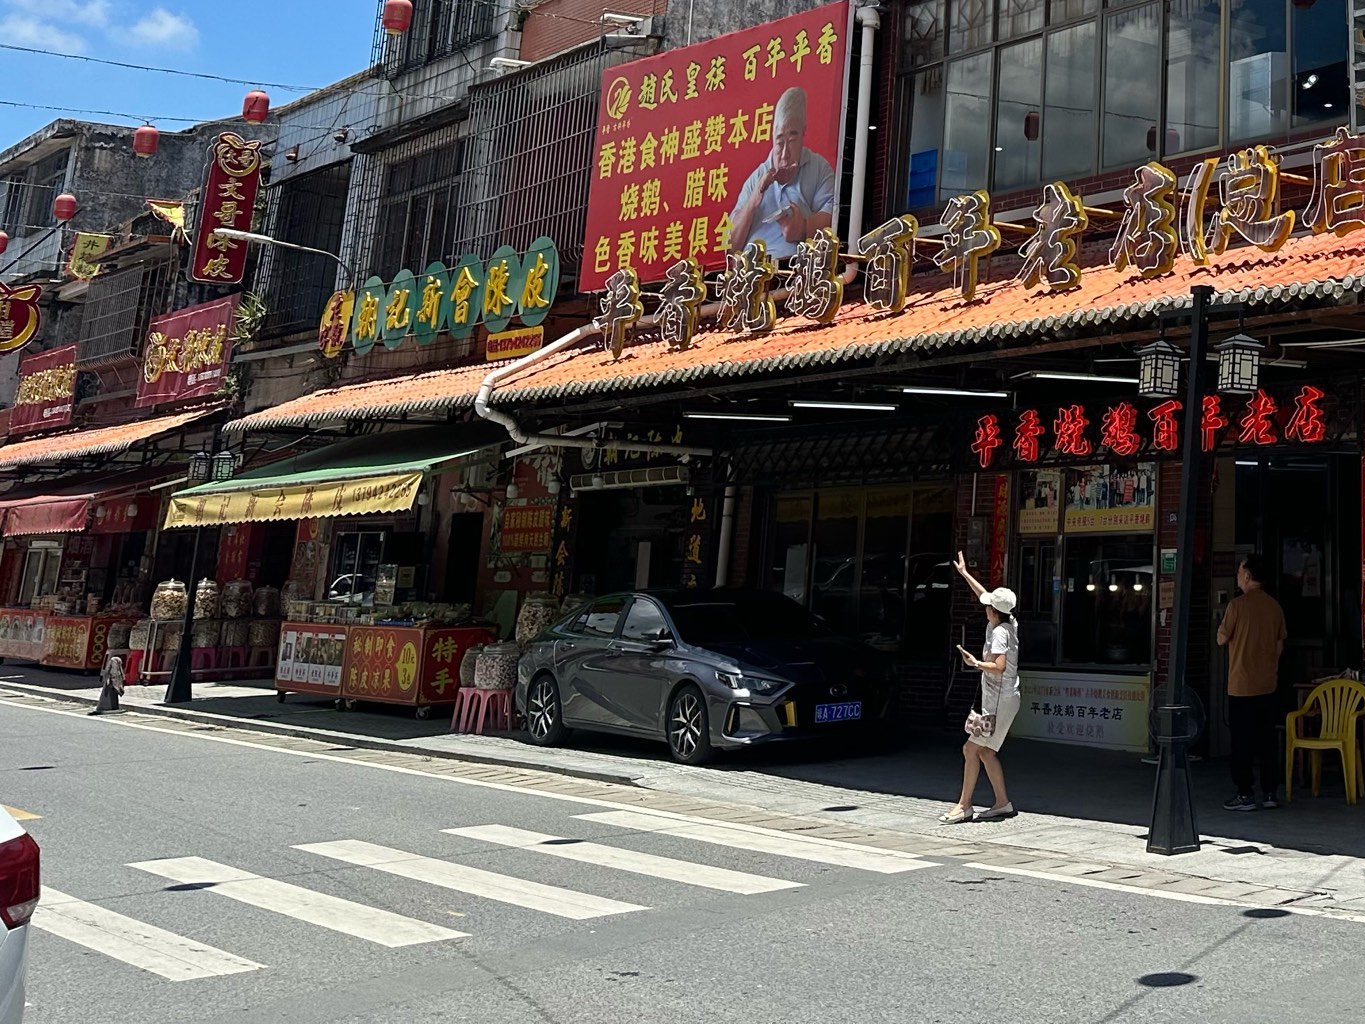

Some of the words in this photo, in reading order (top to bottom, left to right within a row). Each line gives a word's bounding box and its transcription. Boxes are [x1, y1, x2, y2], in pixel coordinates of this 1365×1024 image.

[742, 22, 838, 81] 百年平香
[598, 102, 775, 180] 香港食神盛赞本店
[618, 163, 729, 222] 烧鹅、腊味
[594, 212, 735, 274] 色香味美俱全
[1030, 702, 1123, 721] 平香烧鹅百年老店
